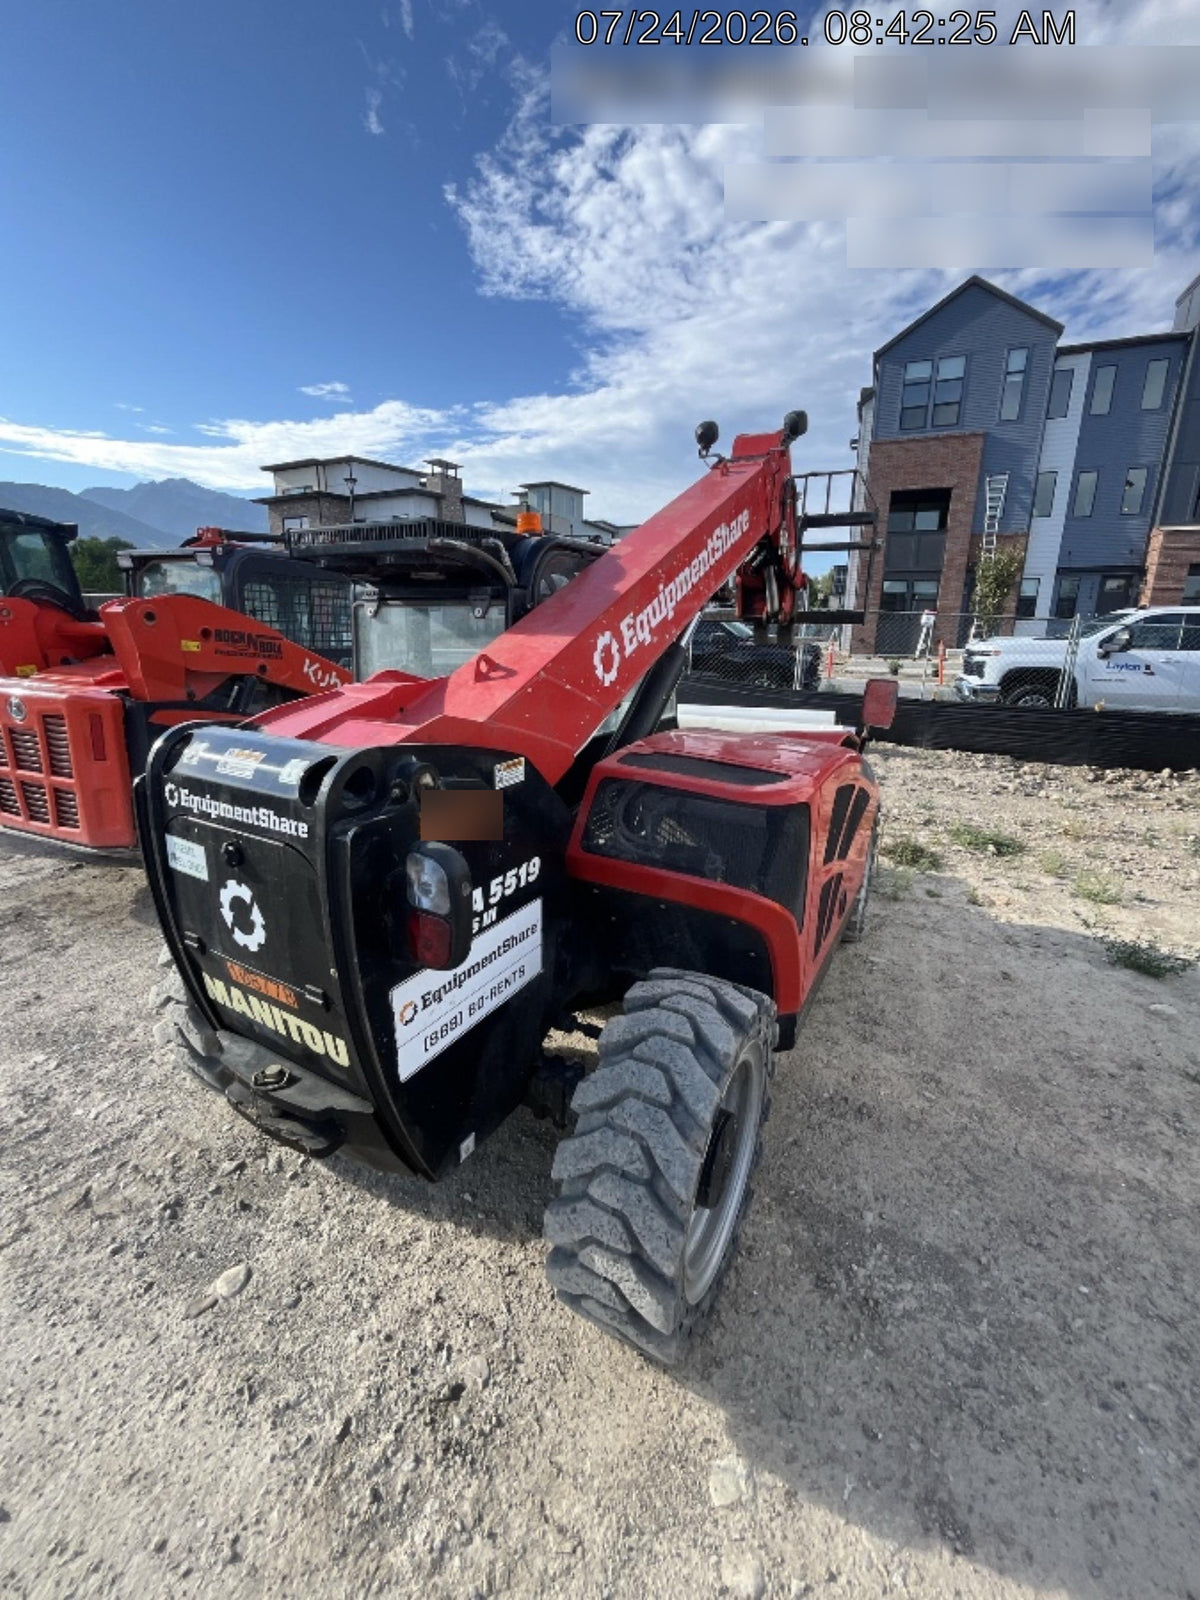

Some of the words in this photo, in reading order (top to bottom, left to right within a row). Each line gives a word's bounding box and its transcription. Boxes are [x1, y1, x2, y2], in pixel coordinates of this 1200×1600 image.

[620, 509, 750, 658] EquipmentShare
[179, 787, 309, 838] EquipmentShare
[488, 856, 541, 905] 5519
[420, 922, 538, 1011] EquipmentShare
[202, 971, 350, 1068] MANITOU
